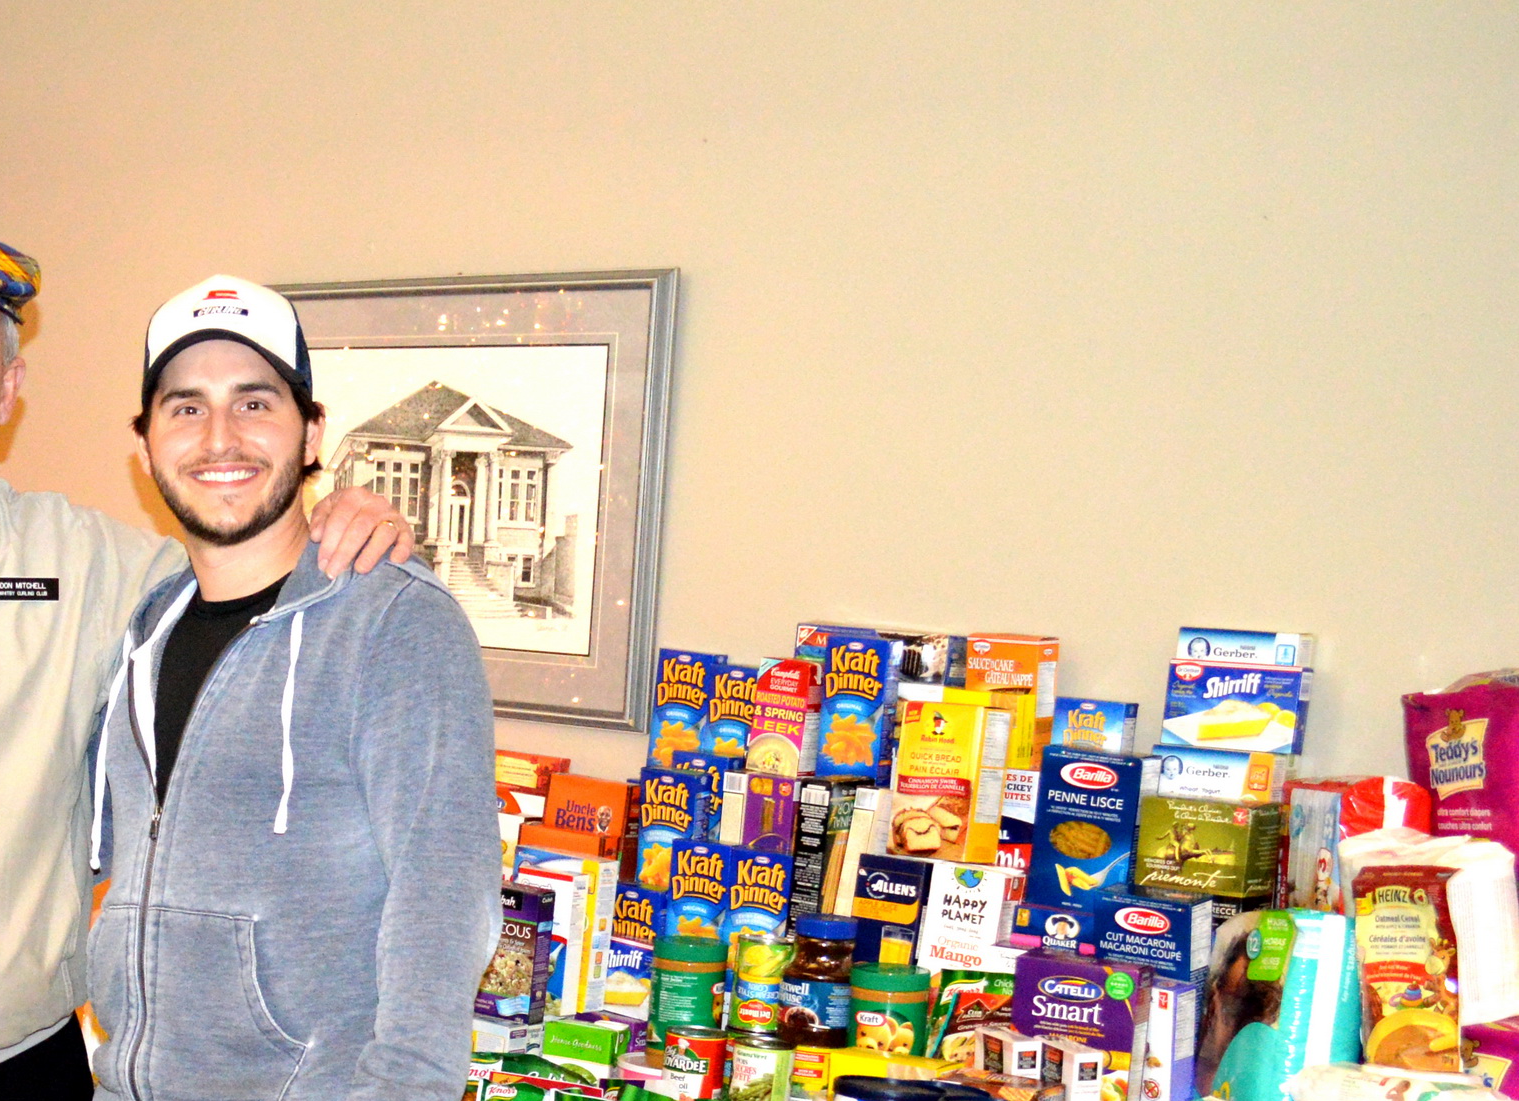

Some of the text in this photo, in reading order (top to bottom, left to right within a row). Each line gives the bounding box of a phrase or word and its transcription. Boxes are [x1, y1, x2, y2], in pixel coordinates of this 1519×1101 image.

[0, 581, 47, 590] DON MITCHELL
[830, 644, 881, 677] Kraft
[967, 657, 1015, 672] SAUCE CAKE
[662, 658, 707, 688] Kraft
[770, 667, 801, 681] Campbell's
[984, 669, 1011, 685] GÂTEAU
[769, 677, 798, 688] EVERYDAY
[769, 684, 798, 694] GOURMET
[825, 672, 883, 699] Dinner
[1203, 673, 1262, 700] Shirriff
[656, 682, 708, 711] Dinner
[756, 690, 806, 708] ROASTED POTATO
[709, 697, 755, 723] Dinne
[754, 705, 804, 722] & SPRING
[752, 719, 801, 736] LEEK
[1067, 709, 1106, 733] Kraft
[920, 734, 956, 744] Robin Hood
[1062, 727, 1108, 747] Dinner
[910, 752, 962, 764] QUICK BREAD
[1430, 737, 1479, 764] Teddy's
[909, 764, 927, 774] PAIN
[1073, 767, 1113, 784] Barilla
[1430, 762, 1485, 786] Nounours
[900, 781, 930, 790] TOURBILLON
[938, 784, 966, 792] CANNELLE
[908, 777, 957, 786] CINNAMON SWIRL
[644, 777, 690, 810] Kraft
[1047, 788, 1124, 811] PENNE LISCE
[566, 799, 597, 817] Uncle
[1448, 807, 1491, 819] comfort diapers
[640, 803, 693, 833] Dinner
[1437, 821, 1493, 831] couches confort
[677, 850, 724, 882] Kraft
[737, 858, 786, 892] Kraft
[1139, 869, 1236, 889] piemonte
[671, 875, 727, 905] Dinner
[871, 879, 917, 898] ALLEN'S
[1377, 888, 1409, 904] HEINZ
[730, 884, 787, 916] Dinner
[942, 894, 988, 914] HAPPY
[941, 909, 985, 926] PLANET
[1126, 912, 1167, 929] Barilla
[1374, 914, 1401, 923] Oatmeal
[937, 935, 979, 951] Organic
[1042, 935, 1077, 950] QUAKER
[1105, 931, 1176, 950] CUT MACARONI
[1247, 936, 1260, 952] 12
[1368, 934, 1426, 943] Céréales d'avoine
[929, 944, 983, 968] Mango
[1099, 940, 1182, 962] MACARONI COUPÉ
[1044, 978, 1096, 999] CATELLI
[1031, 995, 1103, 1024] Smart
[859, 1014, 879, 1024] Kraft
[669, 1072, 686, 1083] Beef
[487, 1085, 517, 1097] Knorr
